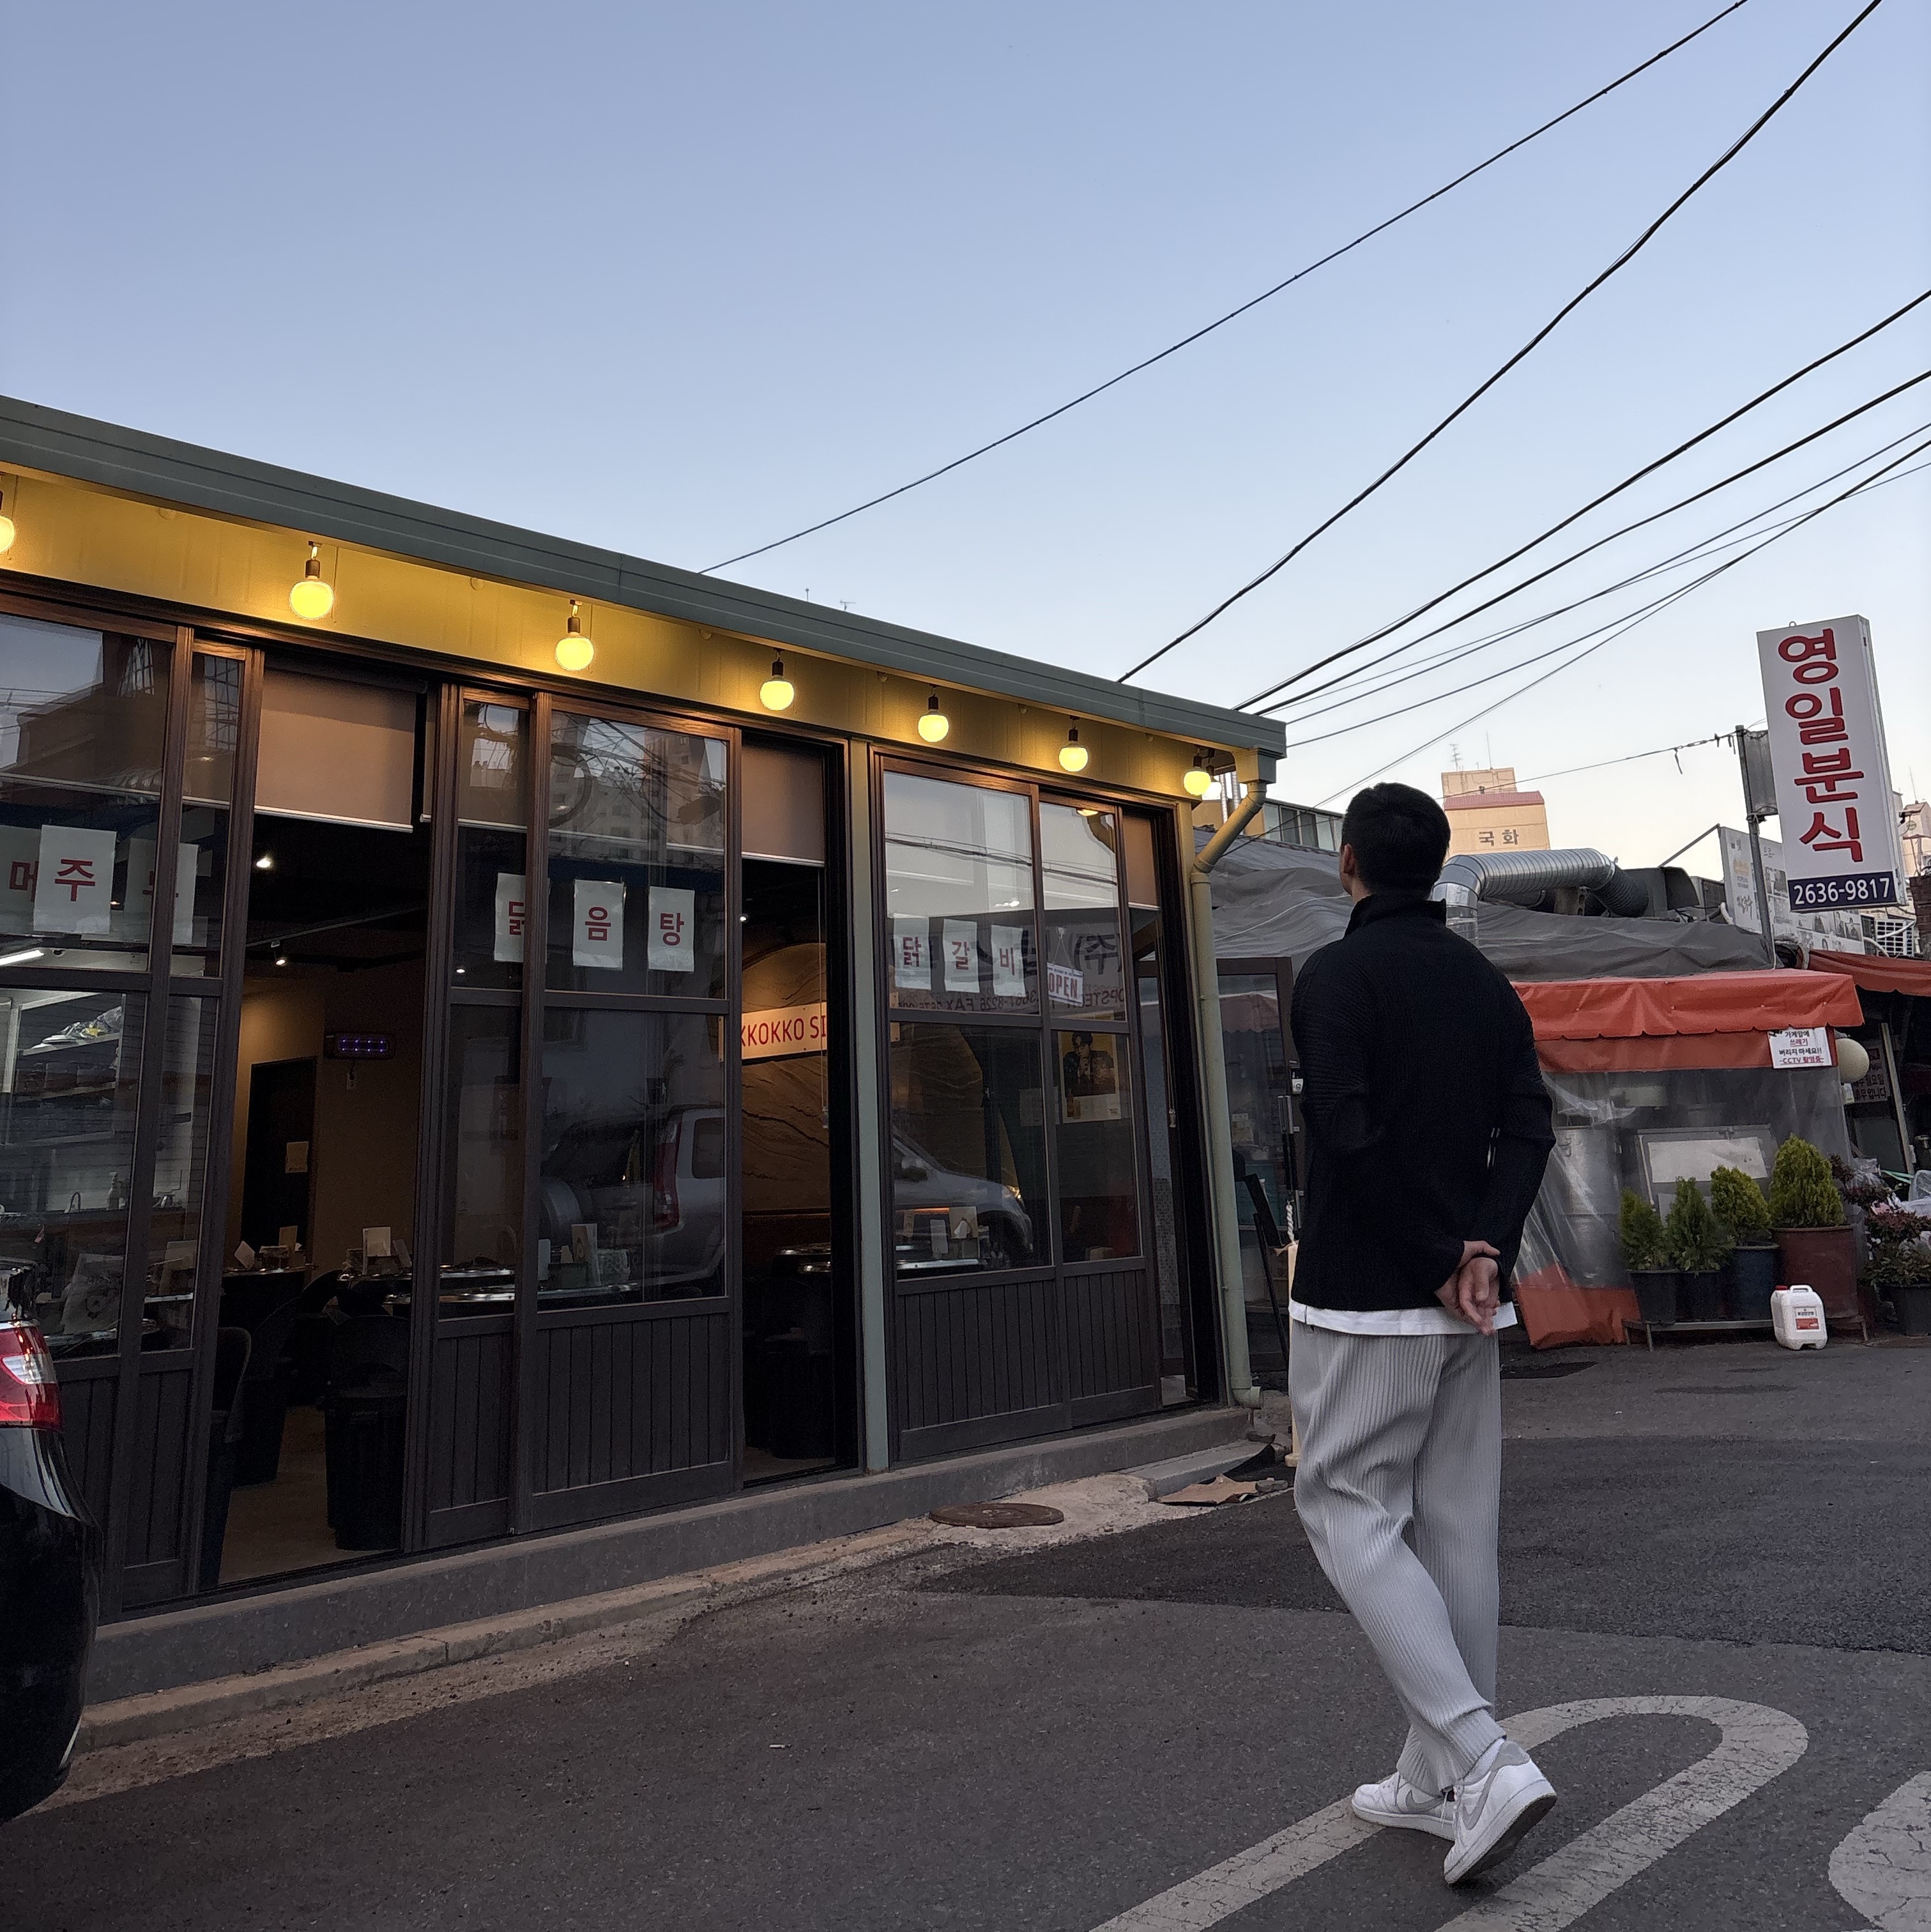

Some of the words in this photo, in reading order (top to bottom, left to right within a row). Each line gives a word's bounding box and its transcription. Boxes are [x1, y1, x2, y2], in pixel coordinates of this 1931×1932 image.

[1778, 628, 1865, 862] 영일분식
[1479, 829, 1519, 847] 국화
[1793, 877, 1891, 905] 2636-9817
[1048, 972, 1078, 999] OPEN
